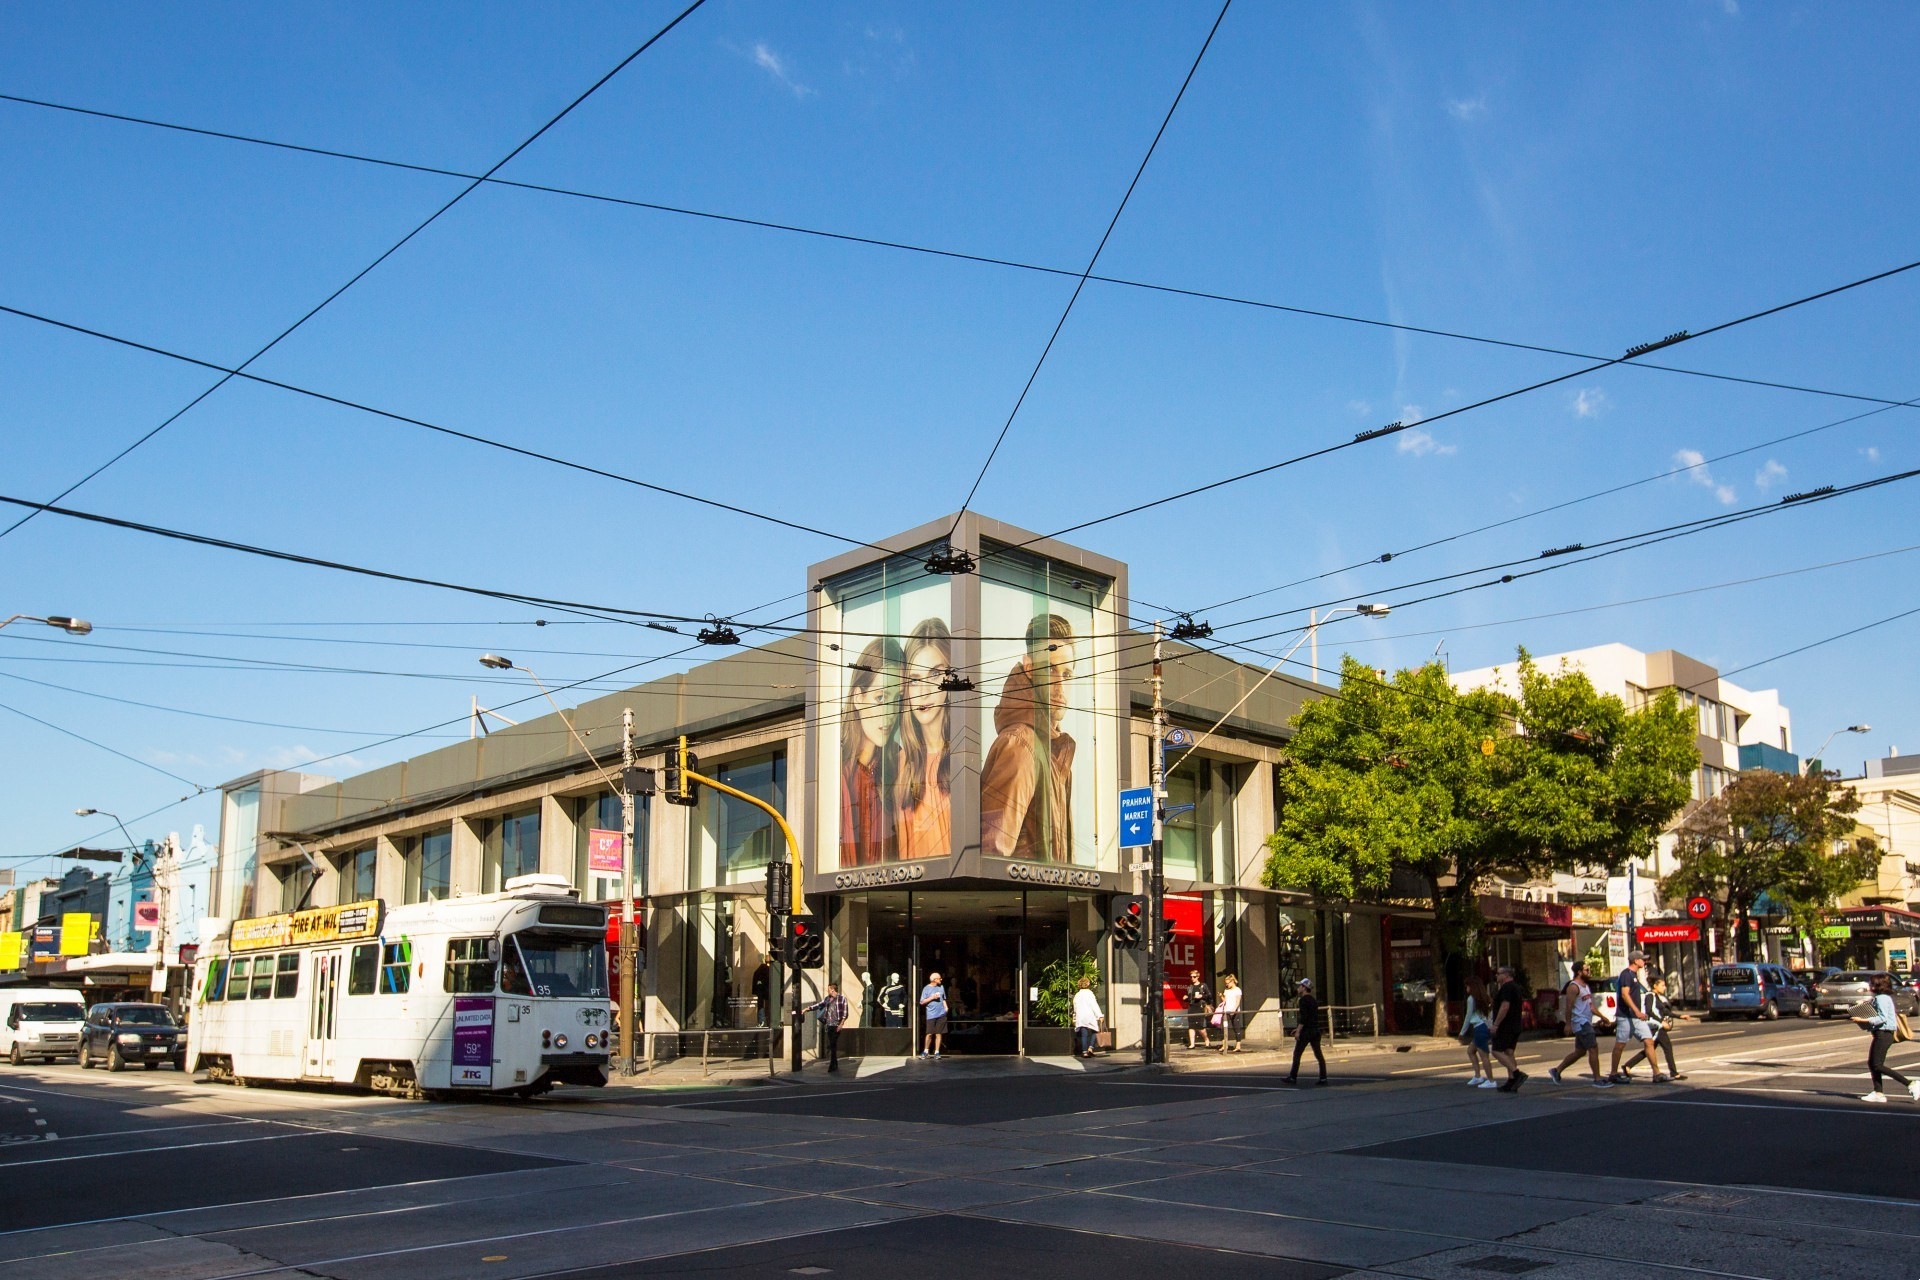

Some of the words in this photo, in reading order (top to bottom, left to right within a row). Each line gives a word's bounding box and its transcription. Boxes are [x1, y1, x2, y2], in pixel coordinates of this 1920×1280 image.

[1121, 796, 1151, 808] PRAHRAN
[1124, 810, 1149, 821] MARKET
[1130, 862, 1147, 871] CHAPEL
[835, 868, 890, 888] COUNTRY
[890, 865, 924, 883] ROAD
[1008, 863, 1068, 885] COUNTRY
[1068, 870, 1101, 887] ROAD
[1692, 902, 1707, 913] 40
[293, 916, 309, 934] FIRE
[310, 914, 321, 932] AT
[323, 913, 337, 930] WIL
[1644, 929, 1689, 939] ALPHALYNX
[1765, 926, 1792, 934] TATTOO
[1162, 944, 1195, 966] ALE
[1717, 968, 1751, 977] PANOPLY
[537, 985, 551, 995] 35
[590, 988, 601, 996] PT
[521, 1005, 531, 1015] 35
[462, 1070, 482, 1080] TPG
